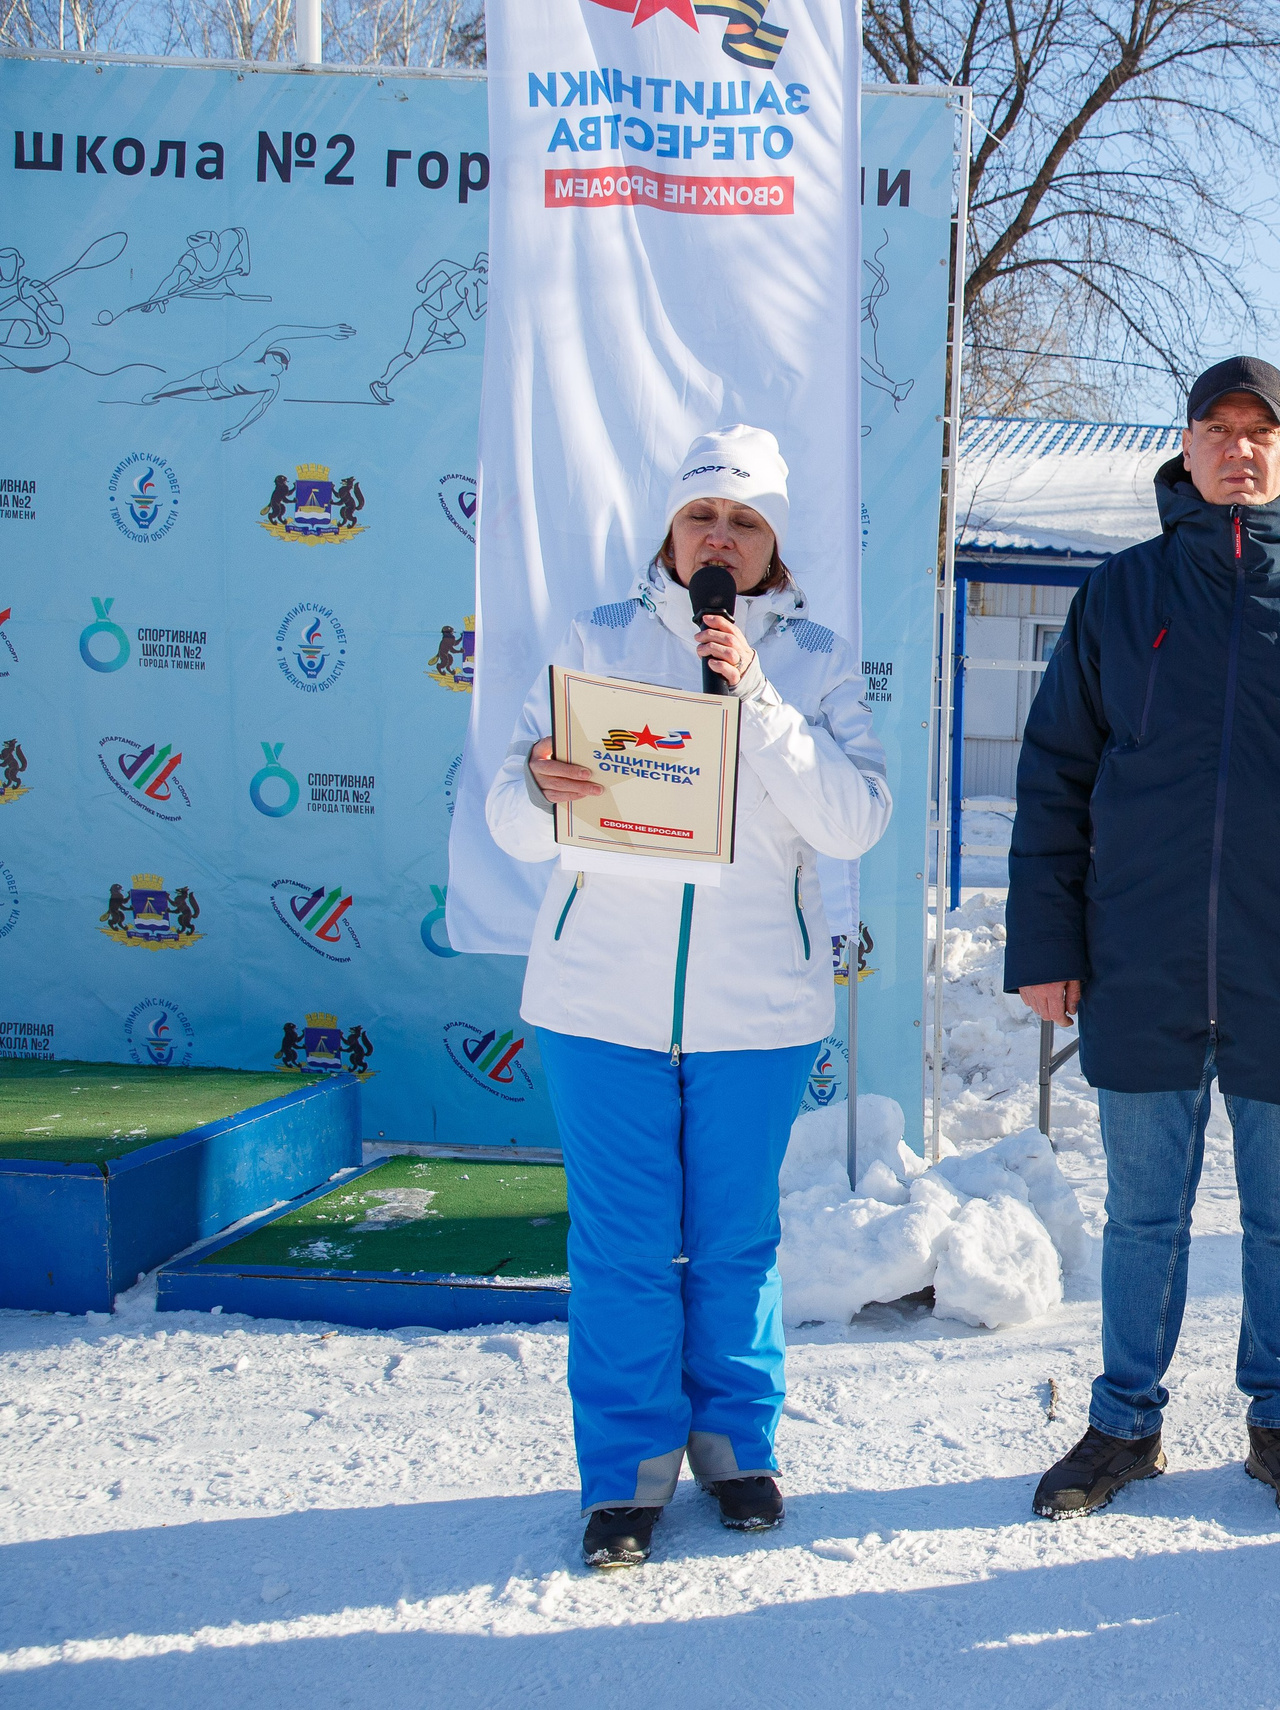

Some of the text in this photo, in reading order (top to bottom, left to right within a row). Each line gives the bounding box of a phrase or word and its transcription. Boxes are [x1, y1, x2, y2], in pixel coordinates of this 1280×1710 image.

[14, 130, 225, 181] школа
[257, 130, 356, 186] №2
[386, 149, 490, 203] гор
[0, 479, 36, 493] ИВНАЯ
[164, 467, 181, 495] СОВЕТ
[12, 494, 32, 509] №2
[0, 509, 36, 520] ТЮМЕНИ
[150, 510, 179, 542] ОБЛАСТИ
[138, 628, 207, 645] СПОРТИВНАЯ
[329, 617, 347, 645] СОВЕТ
[142, 643, 202, 660] ШКОЛА №2
[139, 657, 206, 671] ГОРОДА ТЮМЕНИ
[319, 659, 346, 692] ОБЛАСТИ
[869, 676, 888, 691] №2
[864, 692, 892, 702] МЕНИ
[444, 753, 464, 786] ОЛИМП
[593, 750, 701, 776] ЗАЩИТНИКИ
[308, 773, 375, 789] СПОРТИВНАЯ
[598, 762, 694, 786] ОТЕЧЕСТВА
[311, 787, 371, 804] ШКОЛА №2
[307, 803, 376, 815] ГОРОДА ТЮМЕНИ
[603, 820, 690, 838] СВОИХ НЕ БРОСАЕМ
[0, 909, 21, 938] БЛАСТИ
[0, 1022, 54, 1037] ОРТИВНАЯ
[176, 1011, 195, 1038] СОВЕТ
[0, 1036, 50, 1051] КОЛА №2
